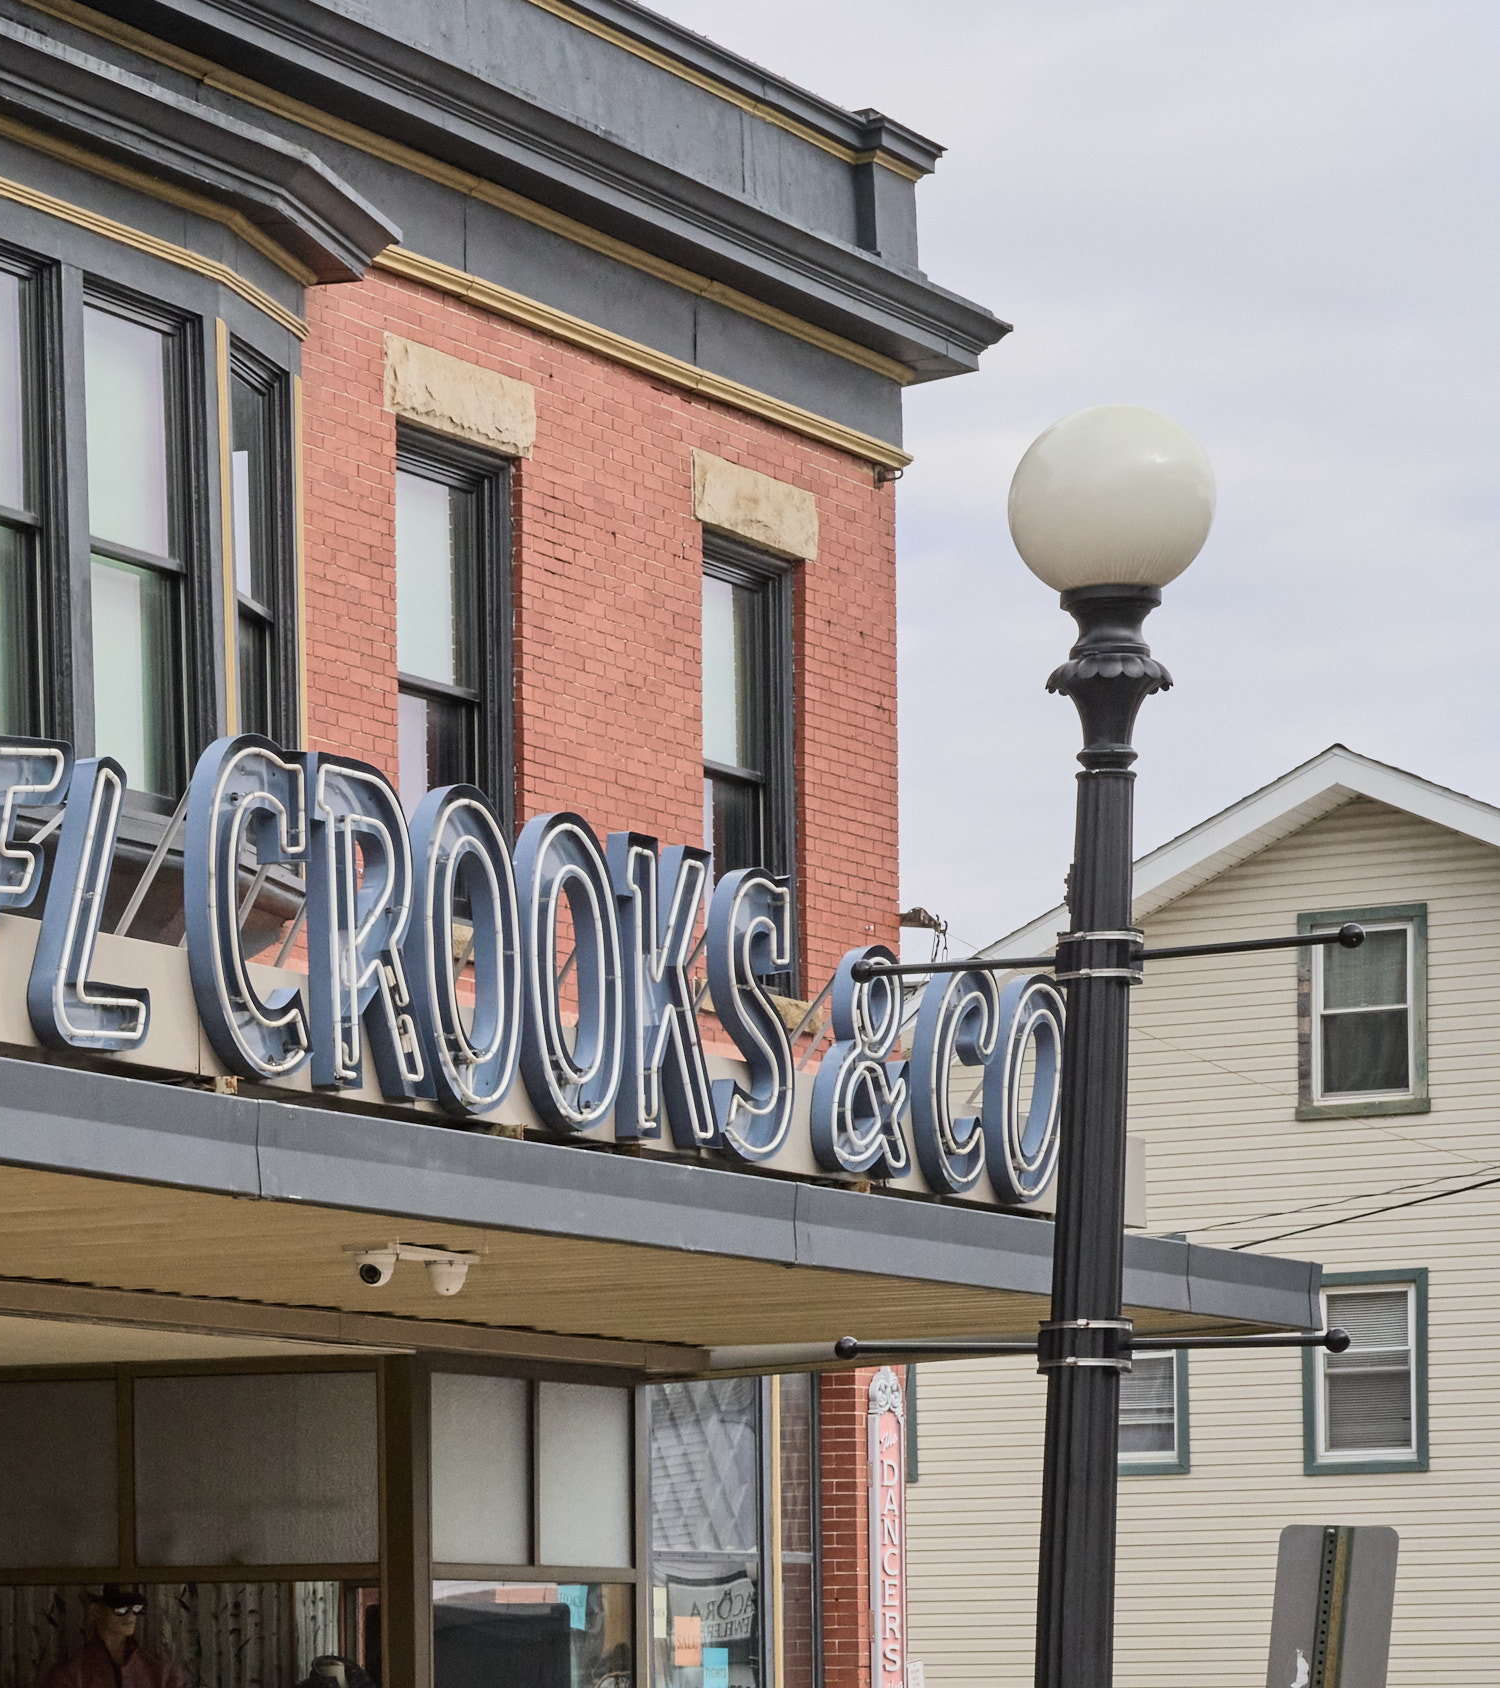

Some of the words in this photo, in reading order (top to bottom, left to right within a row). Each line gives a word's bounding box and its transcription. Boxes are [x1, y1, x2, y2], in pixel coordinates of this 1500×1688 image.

[184, 733, 795, 1163] CROOKS
[811, 944, 911, 1178] &
[911, 956, 1067, 1204] CO
[881, 1431, 898, 1453] The
[881, 1459, 901, 1674] DANCERS
